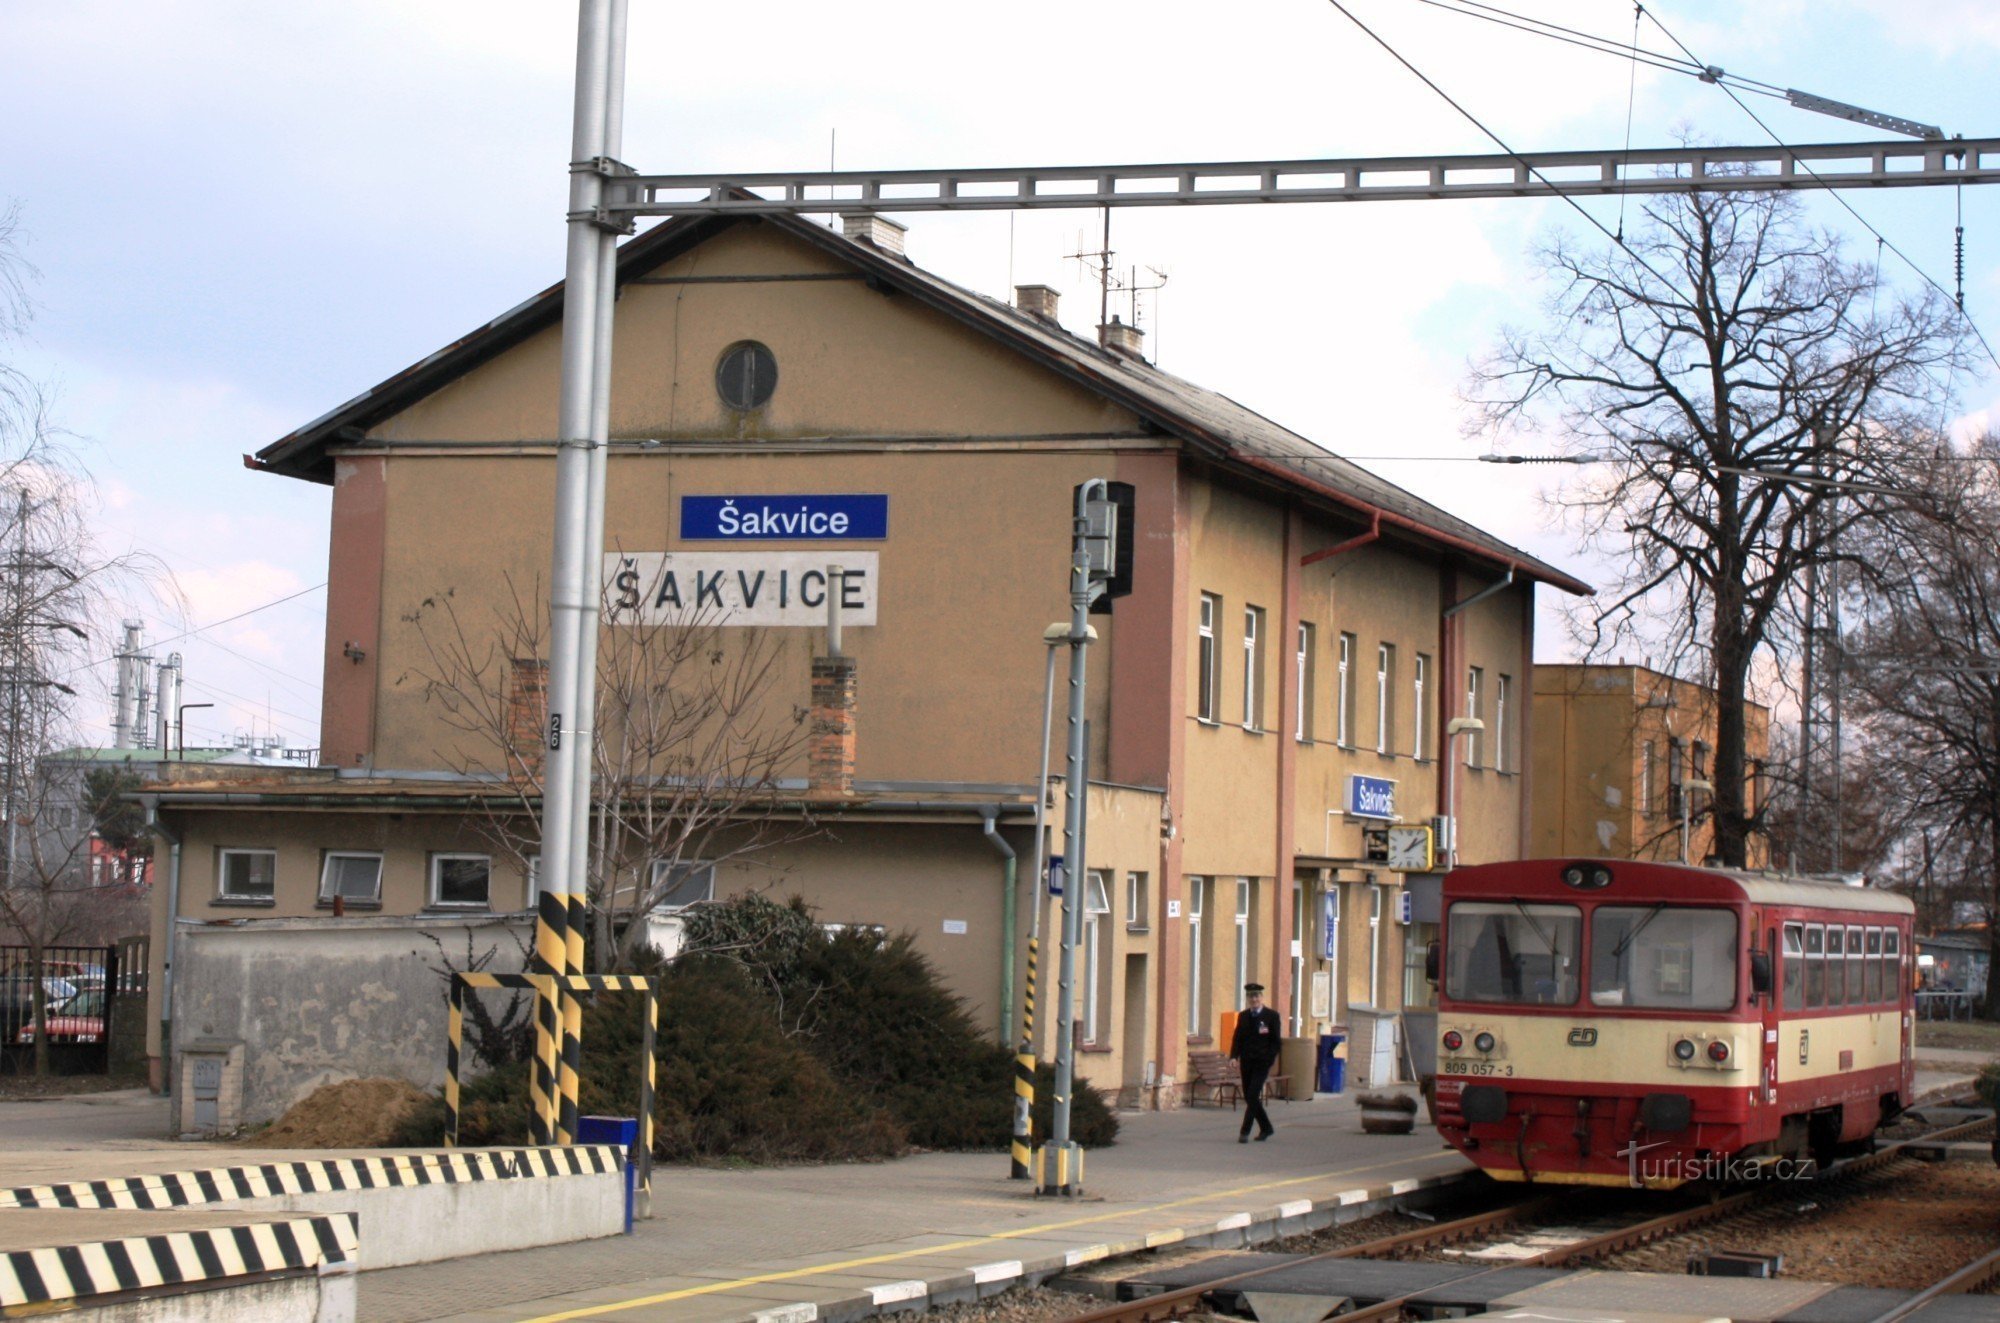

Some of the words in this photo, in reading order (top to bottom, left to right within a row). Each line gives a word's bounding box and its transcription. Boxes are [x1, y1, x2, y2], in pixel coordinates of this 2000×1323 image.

[717, 500, 849, 535] Šakvice
[615, 558, 866, 610] ŠAKVICE
[551, 716, 560, 747] 26
[1445, 1063, 1467, 1074] 809
